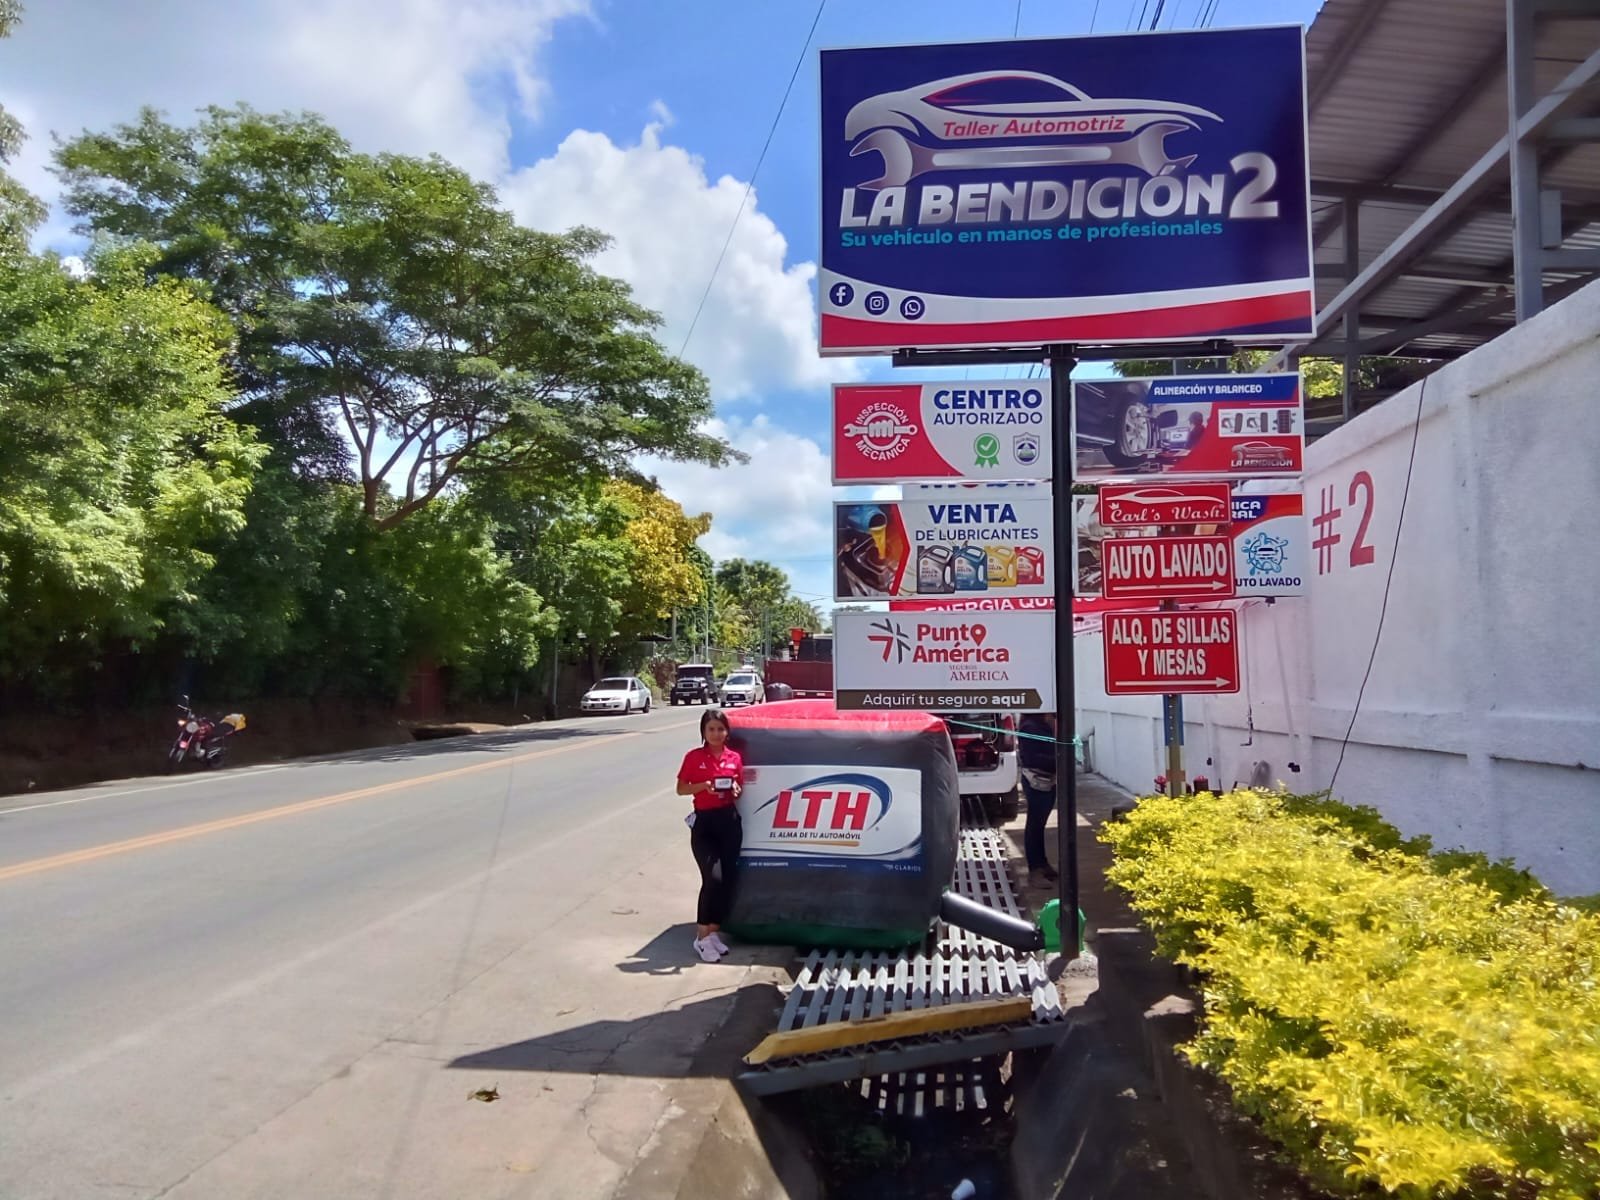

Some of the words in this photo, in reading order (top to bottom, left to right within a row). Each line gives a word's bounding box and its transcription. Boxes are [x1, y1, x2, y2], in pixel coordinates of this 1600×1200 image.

[943, 121, 999, 138] Taller
[1003, 115, 1125, 135] Automotriz
[840, 184, 908, 228] LA
[918, 164, 1227, 226] BENDICIÓN
[1228, 152, 1280, 220] 2
[841, 231, 866, 247] Su
[871, 227, 953, 246] vehículo
[958, 229, 982, 243] en
[987, 225, 1053, 241] manos
[1058, 223, 1082, 240] de
[1087, 220, 1223, 242] profesionales
[933, 389, 1043, 409] CENTRO
[1154, 384, 1206, 396] ALINEACIÓN
[1208, 386, 1214, 395] Y
[1215, 384, 1263, 394] BALANCEO
[855, 402, 909, 425] INSPECCIÓN
[933, 411, 1043, 425] AUTORIZADO
[928, 504, 1017, 524] VENTA
[1111, 508, 1161, 523] Carl's
[915, 530, 935, 541] DE
[938, 528, 1039, 541] LUBRICANTES
[1108, 544, 1155, 580] AUTO
[1160, 542, 1228, 578] LAVADO
[1234, 578, 1257, 587] UTO
[1259, 577, 1302, 587] LAVADO
[1111, 618, 1147, 645] ALQ.
[1152, 617, 1172, 644] DE
[1176, 616, 1230, 644] SILLAS
[912, 642, 1010, 663] América
[1137, 649, 1149, 676] Y
[1153, 648, 1207, 676] MESAS
[950, 671, 1009, 681] AMERICA
[863, 693, 915, 708] Adquirí
[919, 694, 934, 705] tu
[937, 695, 988, 708] seguro
[992, 692, 1026, 708] aquí
[772, 790, 871, 830] LTH
[819, 831, 861, 840] AUTOMÓVIL
